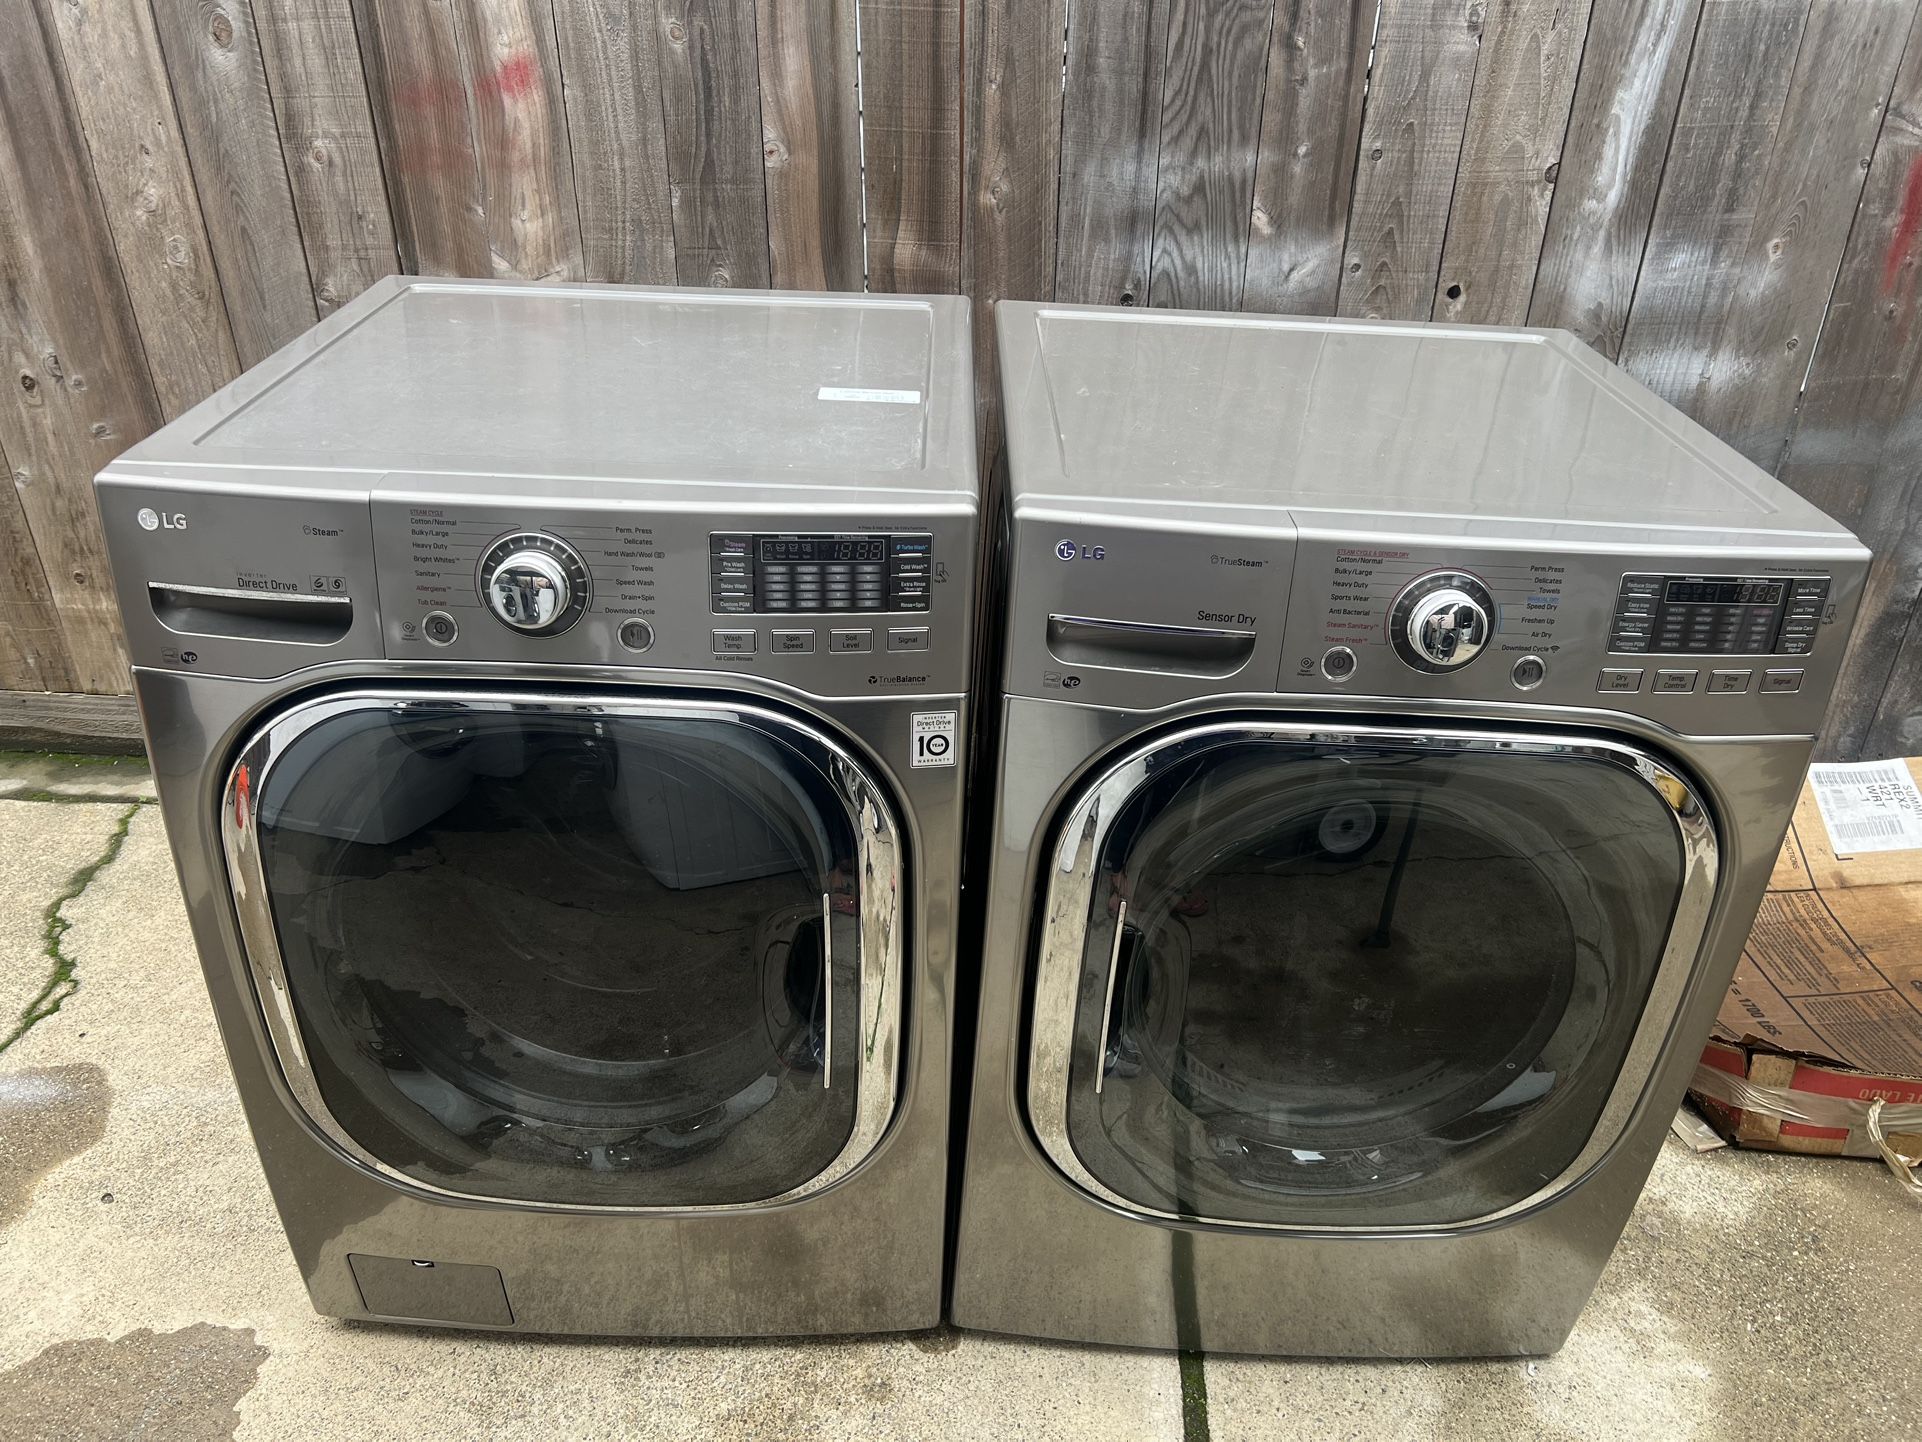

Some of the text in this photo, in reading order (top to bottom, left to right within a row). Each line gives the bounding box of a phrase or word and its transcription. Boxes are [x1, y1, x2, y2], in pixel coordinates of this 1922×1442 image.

[162, 512, 187, 530] LG
[410, 518, 457, 526] Cotton/Normal
[412, 528, 449, 538] Bulky/Large
[412, 542, 448, 550] Heavy Duty
[624, 538, 654, 546] Delicates
[1081, 544, 1105, 560] LG
[414, 555, 432, 564] Bright
[1336, 556, 1384, 564] Cotton/Normal
[632, 564, 654, 572] Towels
[1334, 568, 1373, 576] Bulky/Large
[415, 570, 440, 578] Sanitary
[237, 577, 268, 590] Direct
[270, 580, 298, 591] Drive
[616, 578, 636, 586] Speed
[1354, 581, 1369, 590] Duty
[418, 598, 428, 606] Tub
[1330, 594, 1370, 602] Sports Wear
[604, 606, 656, 616] Download Cycle
[1342, 608, 1371, 616] Bacterial
[1198, 610, 1257, 627] Sensor Dry
[724, 634, 742, 642] Wash
[898, 636, 918, 644] Signal
[1502, 644, 1531, 652] Download
[1723, 682, 1734, 690] Dry
[1773, 678, 1792, 686] Signal
[918, 734, 949, 757] 10
[1866, 785, 1887, 808] WRT
[1878, 784, 1894, 802] 421
[1889, 784, 1911, 810] REX2
[1738, 998, 1765, 1018] 1700
